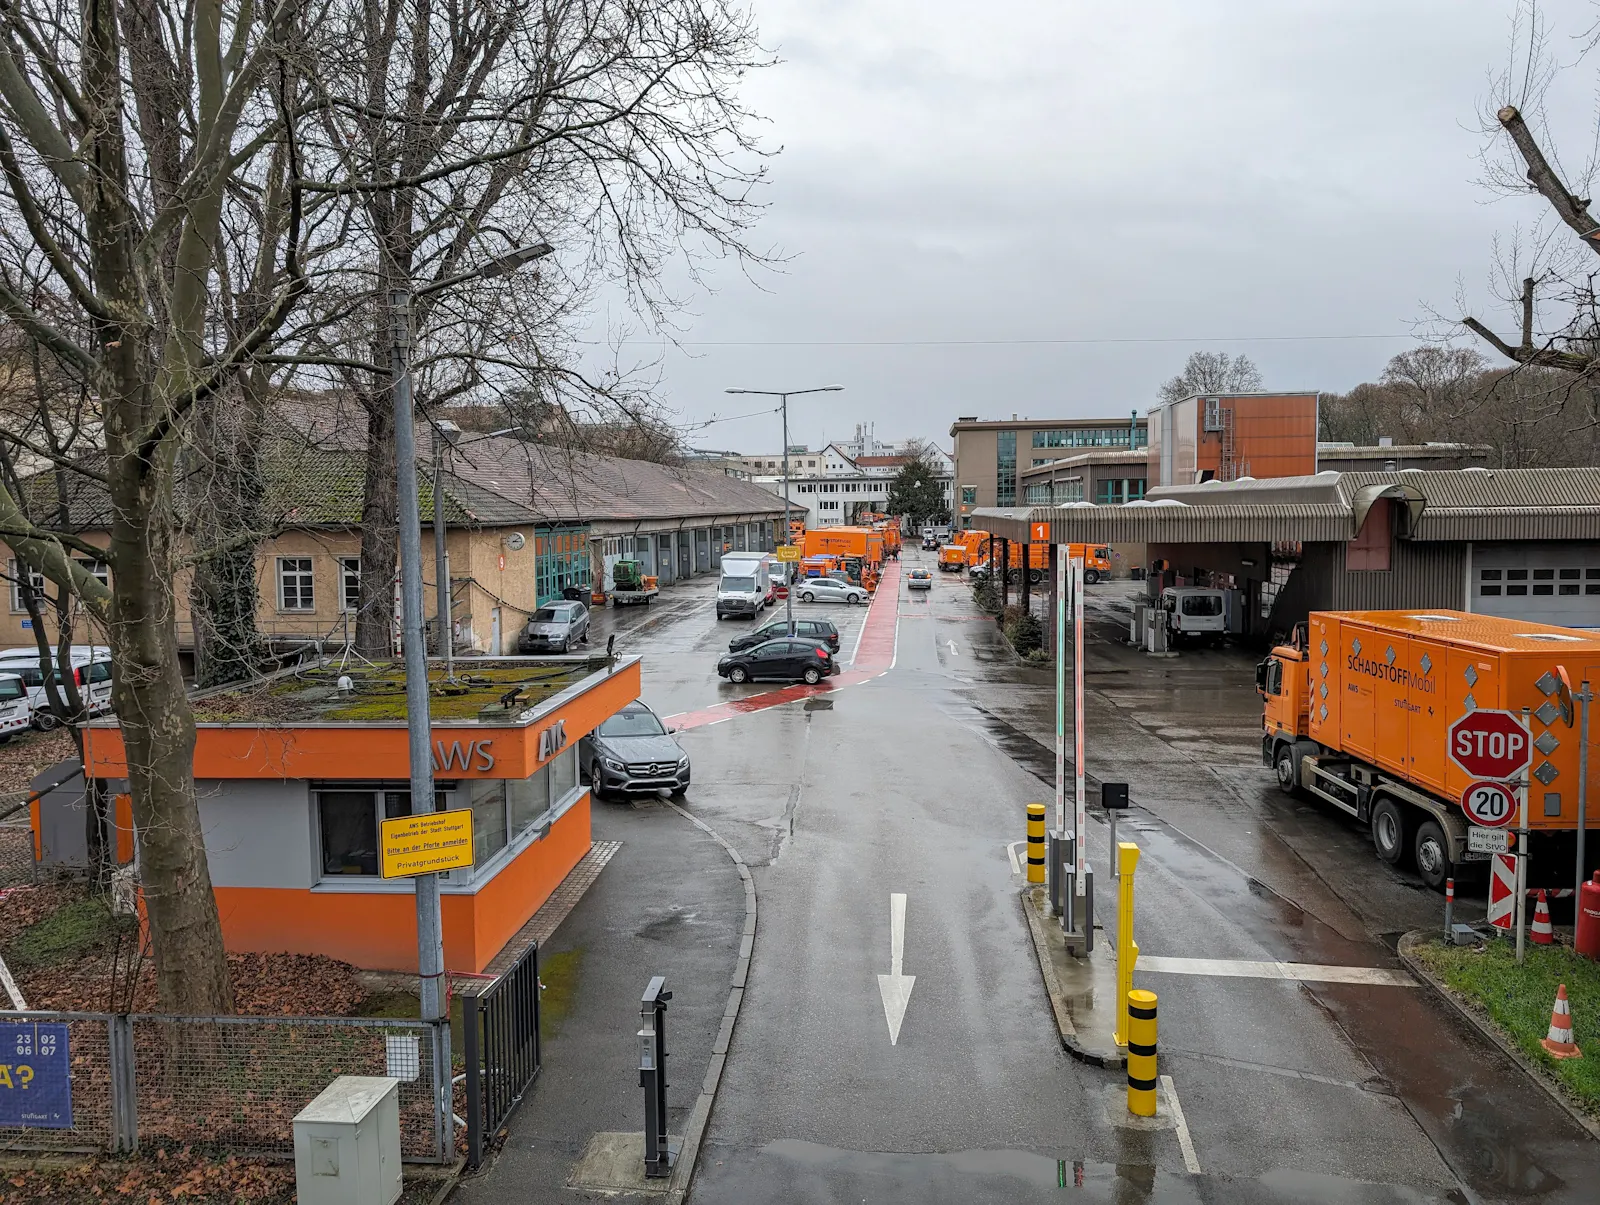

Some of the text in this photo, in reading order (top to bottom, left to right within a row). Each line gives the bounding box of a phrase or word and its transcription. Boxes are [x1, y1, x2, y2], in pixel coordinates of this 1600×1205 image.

[1036, 525, 1044, 538] 1
[1347, 654, 1436, 694] SCHADSTOFFMobil
[1348, 683, 1358, 693] AWS
[1456, 730, 1524, 760] STOP
[1476, 792, 1504, 816] 20
[420, 818, 446, 828] Betriebshof
[390, 830, 418, 840] Eigenbetrieb
[444, 824, 464, 832] Stuttgart
[1472, 832, 1504, 842] Hier gilt
[442, 838, 468, 846] anmelden
[1485, 843, 1506, 852] StVO
[16, 1034, 56, 1044] 23 02
[16, 1046, 56, 1056] 06 07
